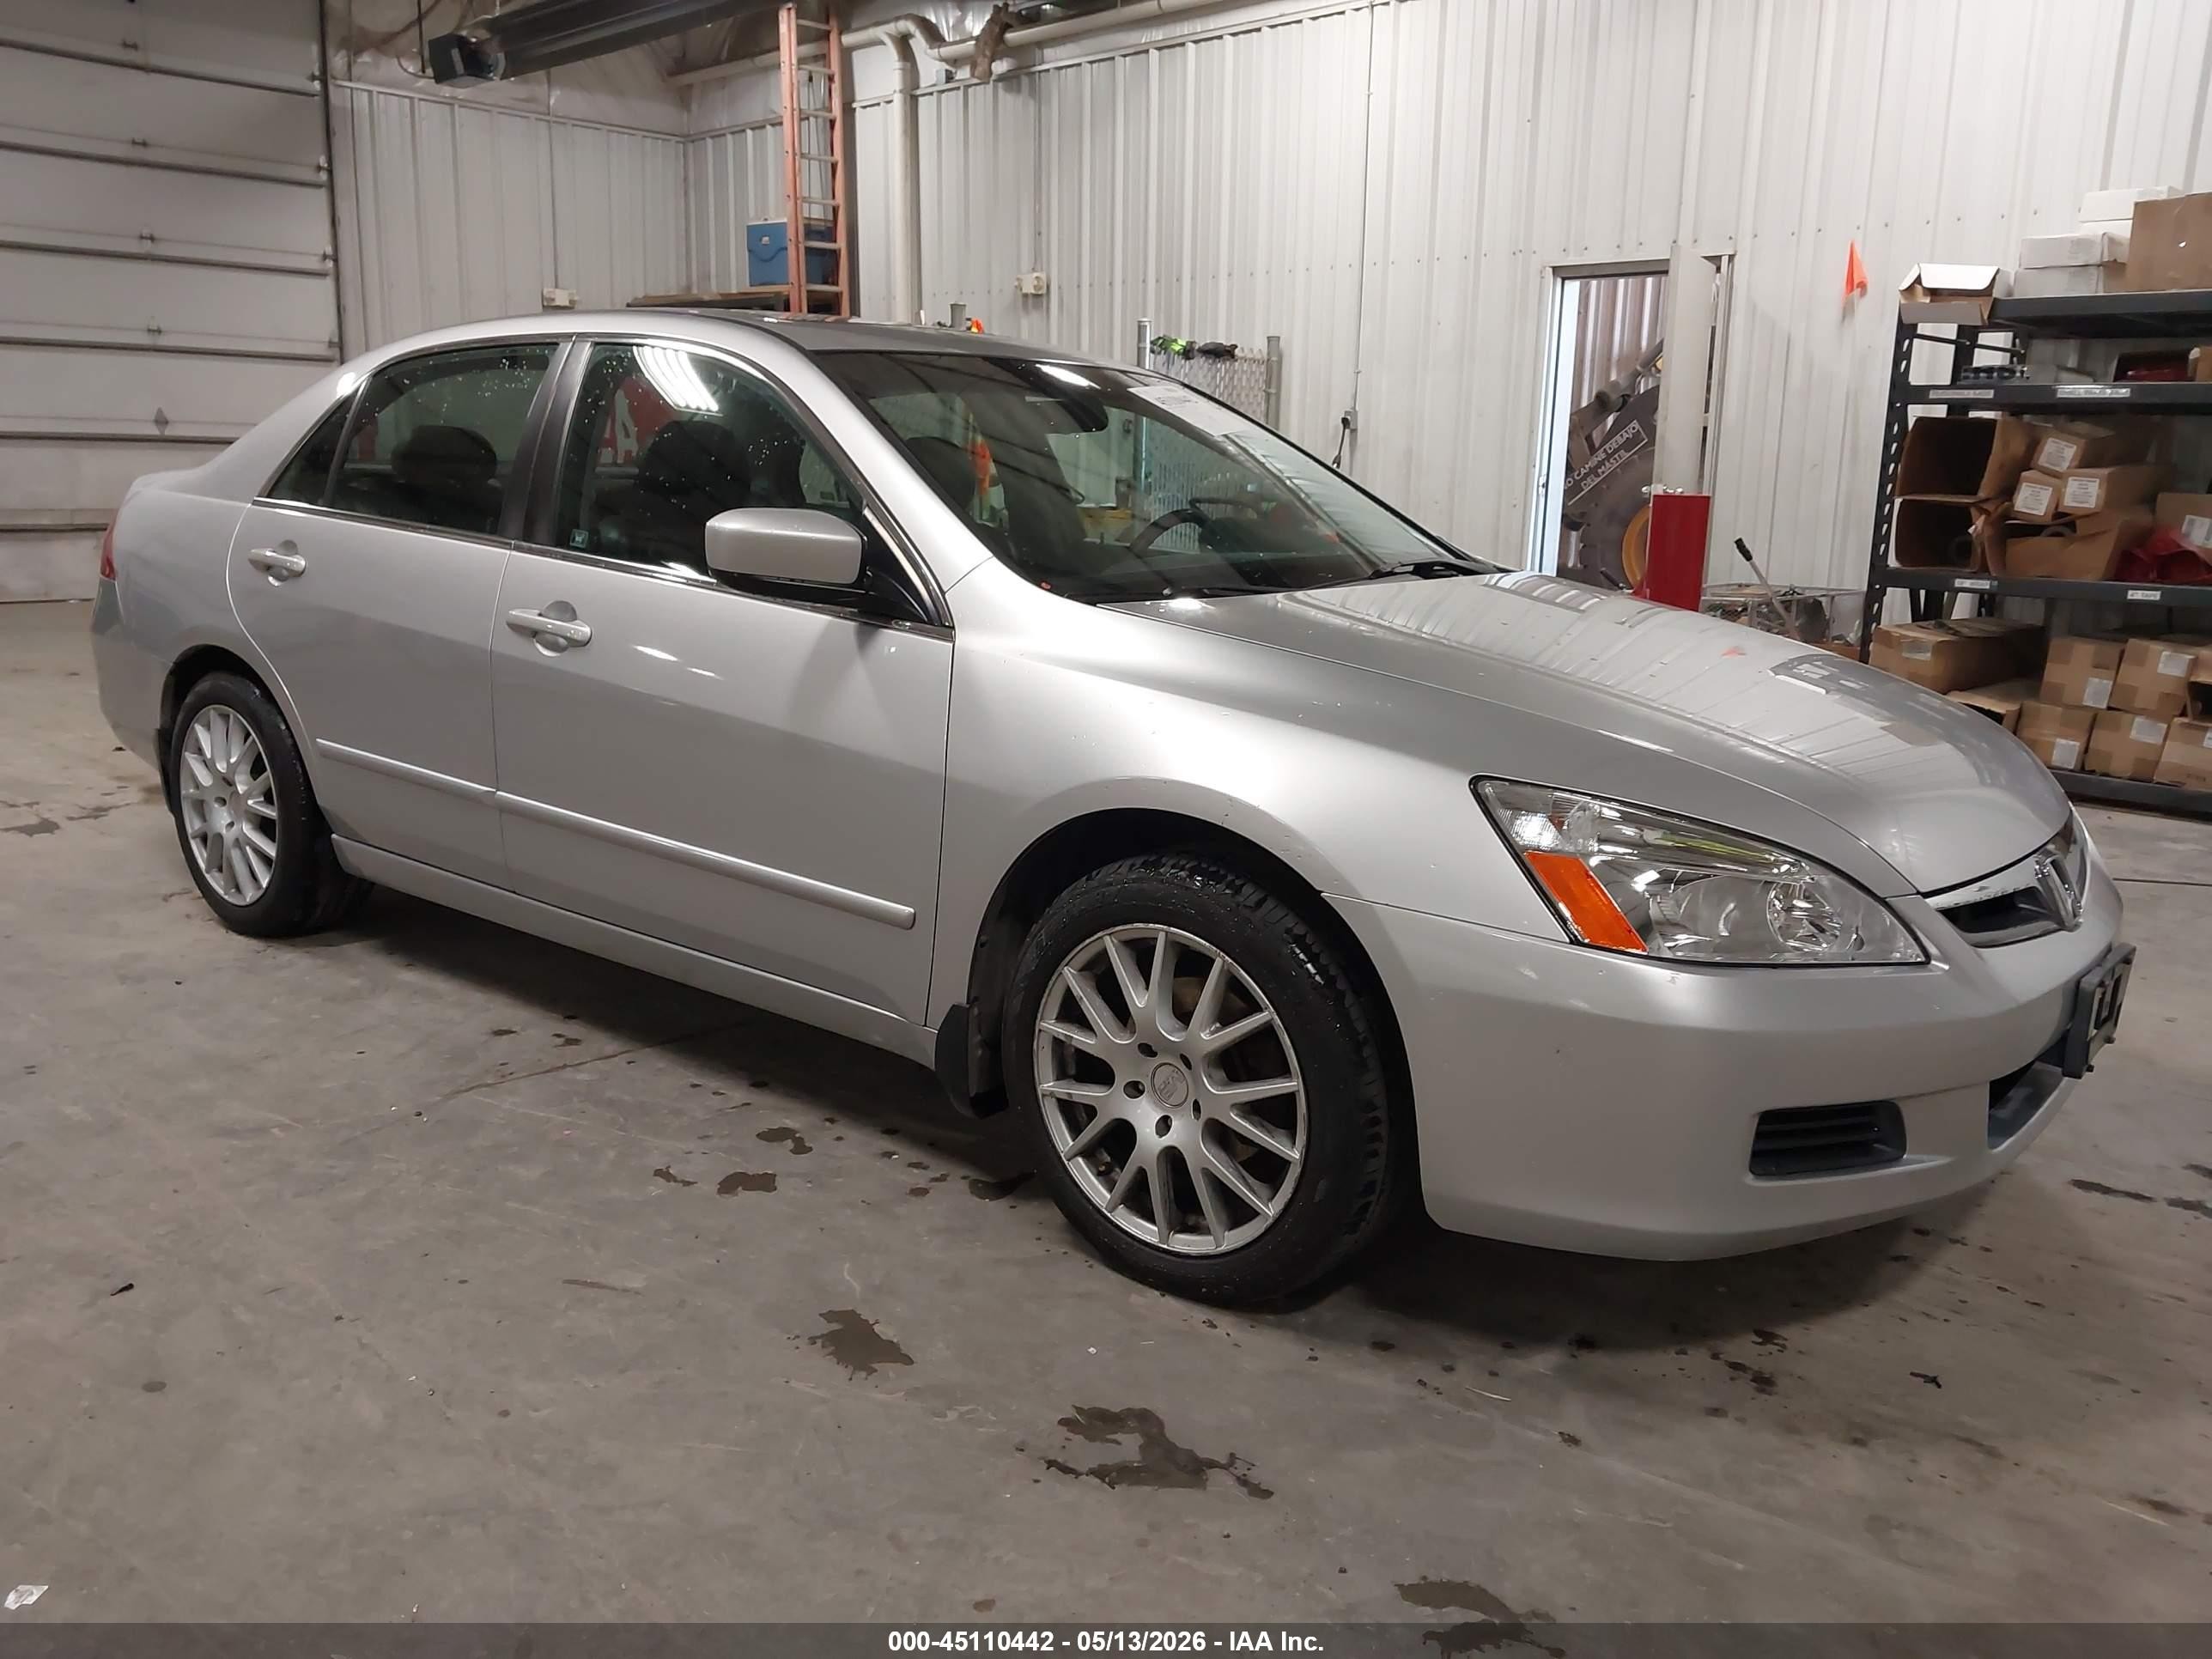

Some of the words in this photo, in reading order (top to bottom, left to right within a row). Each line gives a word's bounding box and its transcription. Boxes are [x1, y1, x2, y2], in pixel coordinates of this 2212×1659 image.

[1574, 451, 1607, 480] CAMINE
[1607, 424, 1638, 454] DEBAJO
[1581, 474, 1598, 490] DEL
